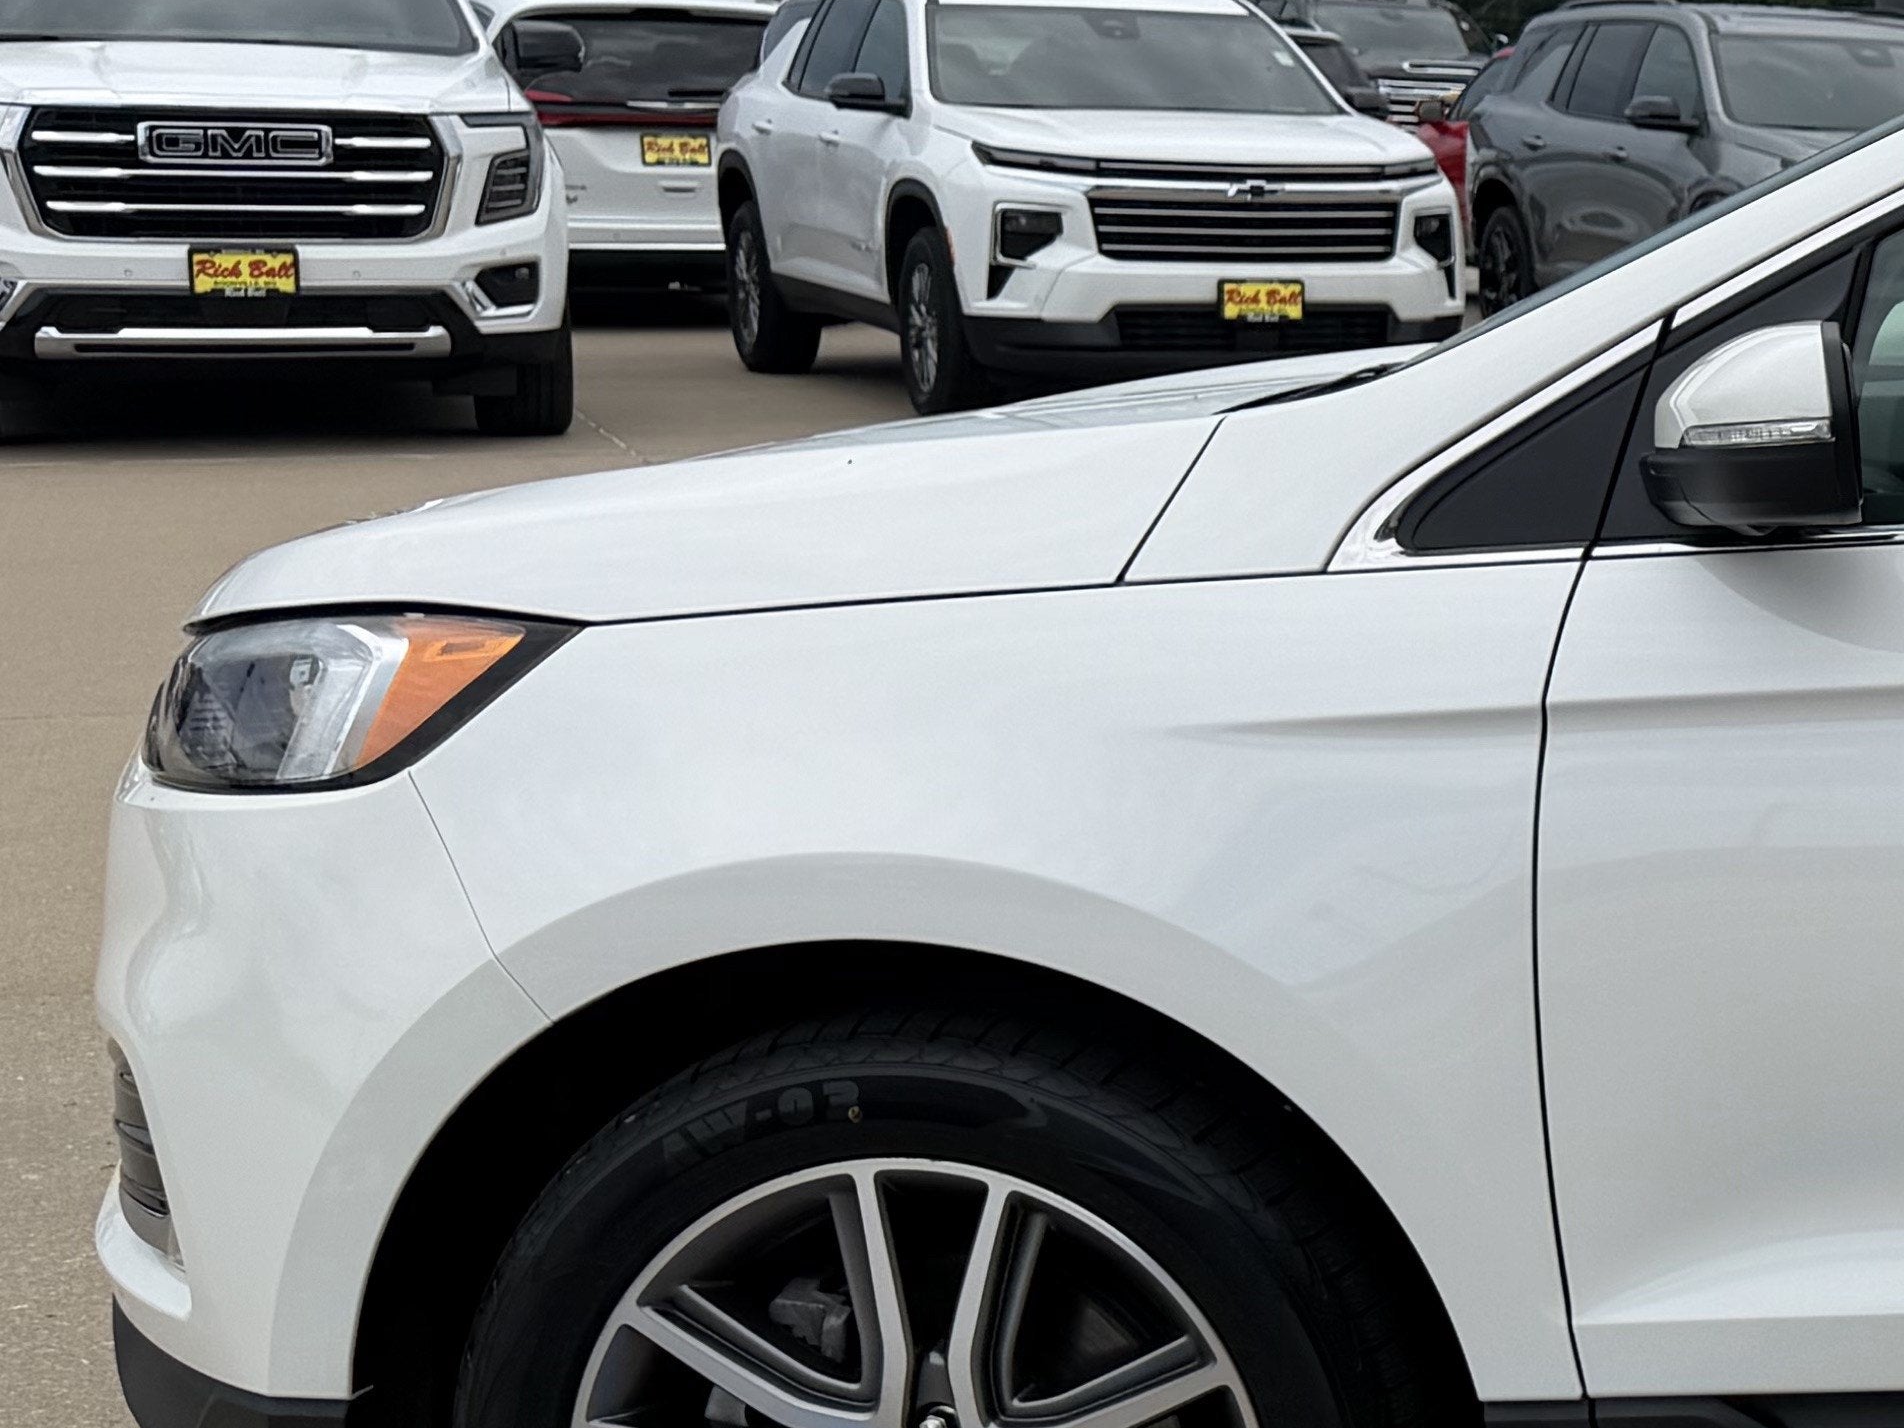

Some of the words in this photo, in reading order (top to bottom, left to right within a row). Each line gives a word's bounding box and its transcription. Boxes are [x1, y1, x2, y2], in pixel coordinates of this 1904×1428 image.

[152, 128, 320, 158] GMC
[195, 259, 242, 278] Rick
[248, 259, 295, 278] Ball
[1226, 288, 1261, 305] Rick
